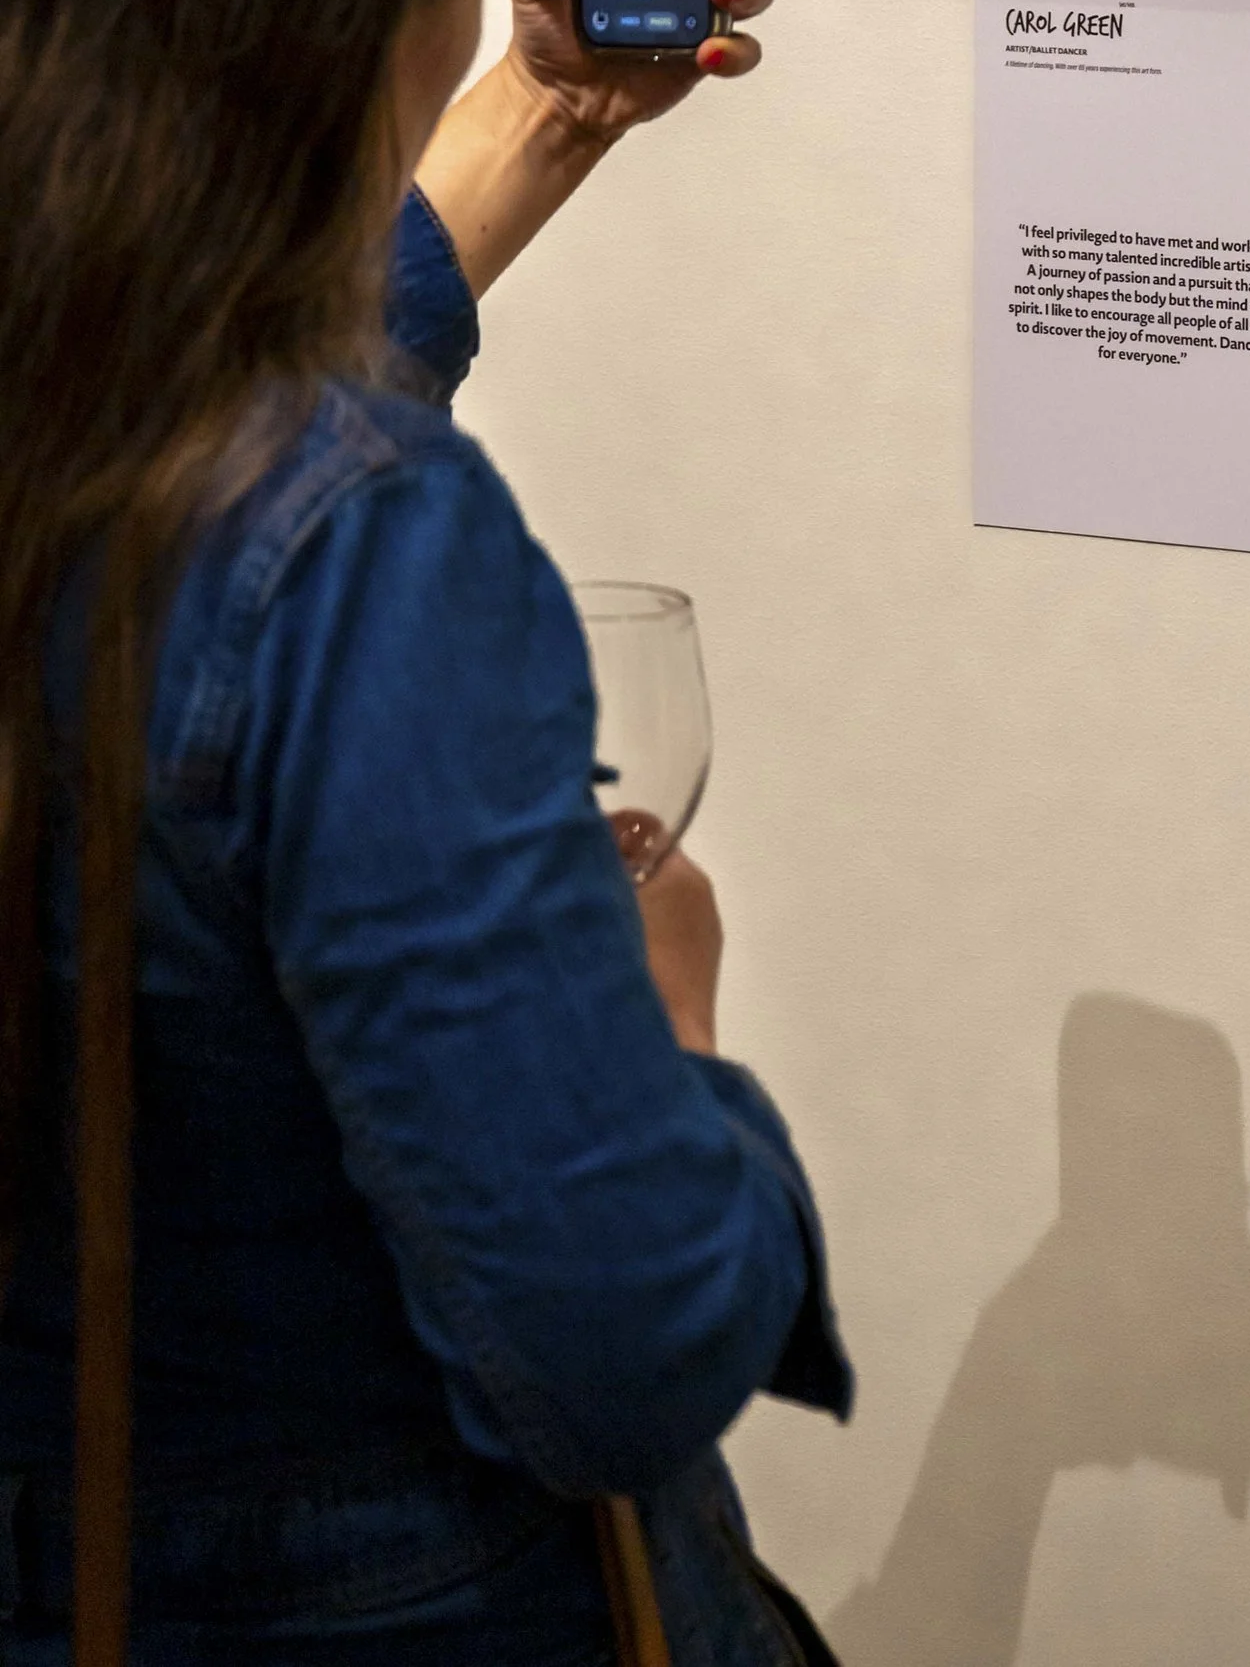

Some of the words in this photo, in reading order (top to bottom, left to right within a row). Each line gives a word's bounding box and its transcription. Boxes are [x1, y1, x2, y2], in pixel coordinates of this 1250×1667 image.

[1006, 8, 1057, 35] CAROL
[1063, 11, 1124, 39] GREEN
[1005, 45, 1058, 55] ARTIST/BALLET
[1058, 47, 1088, 56] DANCER
[1018, 223, 1029, 238] “I
[1031, 224, 1055, 239] feel
[1056, 227, 1118, 247] privileged
[1119, 233, 1133, 245] to
[1135, 231, 1166, 247] have
[1167, 237, 1194, 249] met
[1195, 237, 1219, 251] and
[1021, 244, 1050, 258] with
[1051, 249, 1067, 259] so
[1068, 250, 1104, 266] many
[1105, 249, 1158, 266] talented
[1160, 253, 1221, 270] incredible
[1026, 263, 1037, 276] A
[1037, 263, 1087, 284] journey
[1088, 267, 1103, 281] of
[1103, 270, 1151, 285] passion
[1152, 273, 1176, 287] and
[1178, 277, 1187, 288] a
[1188, 277, 1233, 292] pursuit
[1014, 284, 1036, 296] not
[1037, 283, 1065, 301] only
[1066, 285, 1109, 304] shapes
[1110, 288, 1132, 303] the
[1134, 289, 1167, 309] body
[1168, 292, 1191, 307] but
[1192, 294, 1214, 309] the
[1215, 297, 1248, 311] mind
[1008, 300, 1043, 317] spirit.
[1045, 303, 1049, 316] I
[1051, 302, 1073, 318] like
[1074, 307, 1089, 319] to
[1090, 309, 1155, 327] encourage
[1157, 311, 1172, 325] all
[1173, 314, 1217, 331] people
[1218, 316, 1234, 330] of
[1234, 317, 1249, 331] all
[1016, 321, 1030, 333] to
[1031, 320, 1084, 337] discover
[1085, 324, 1106, 339] the
[1106, 326, 1128, 344] joy
[1129, 328, 1144, 342] of
[1145, 333, 1217, 348] movement.
[1097, 345, 1117, 360] for
[1118, 350, 1188, 366] everyone.”
